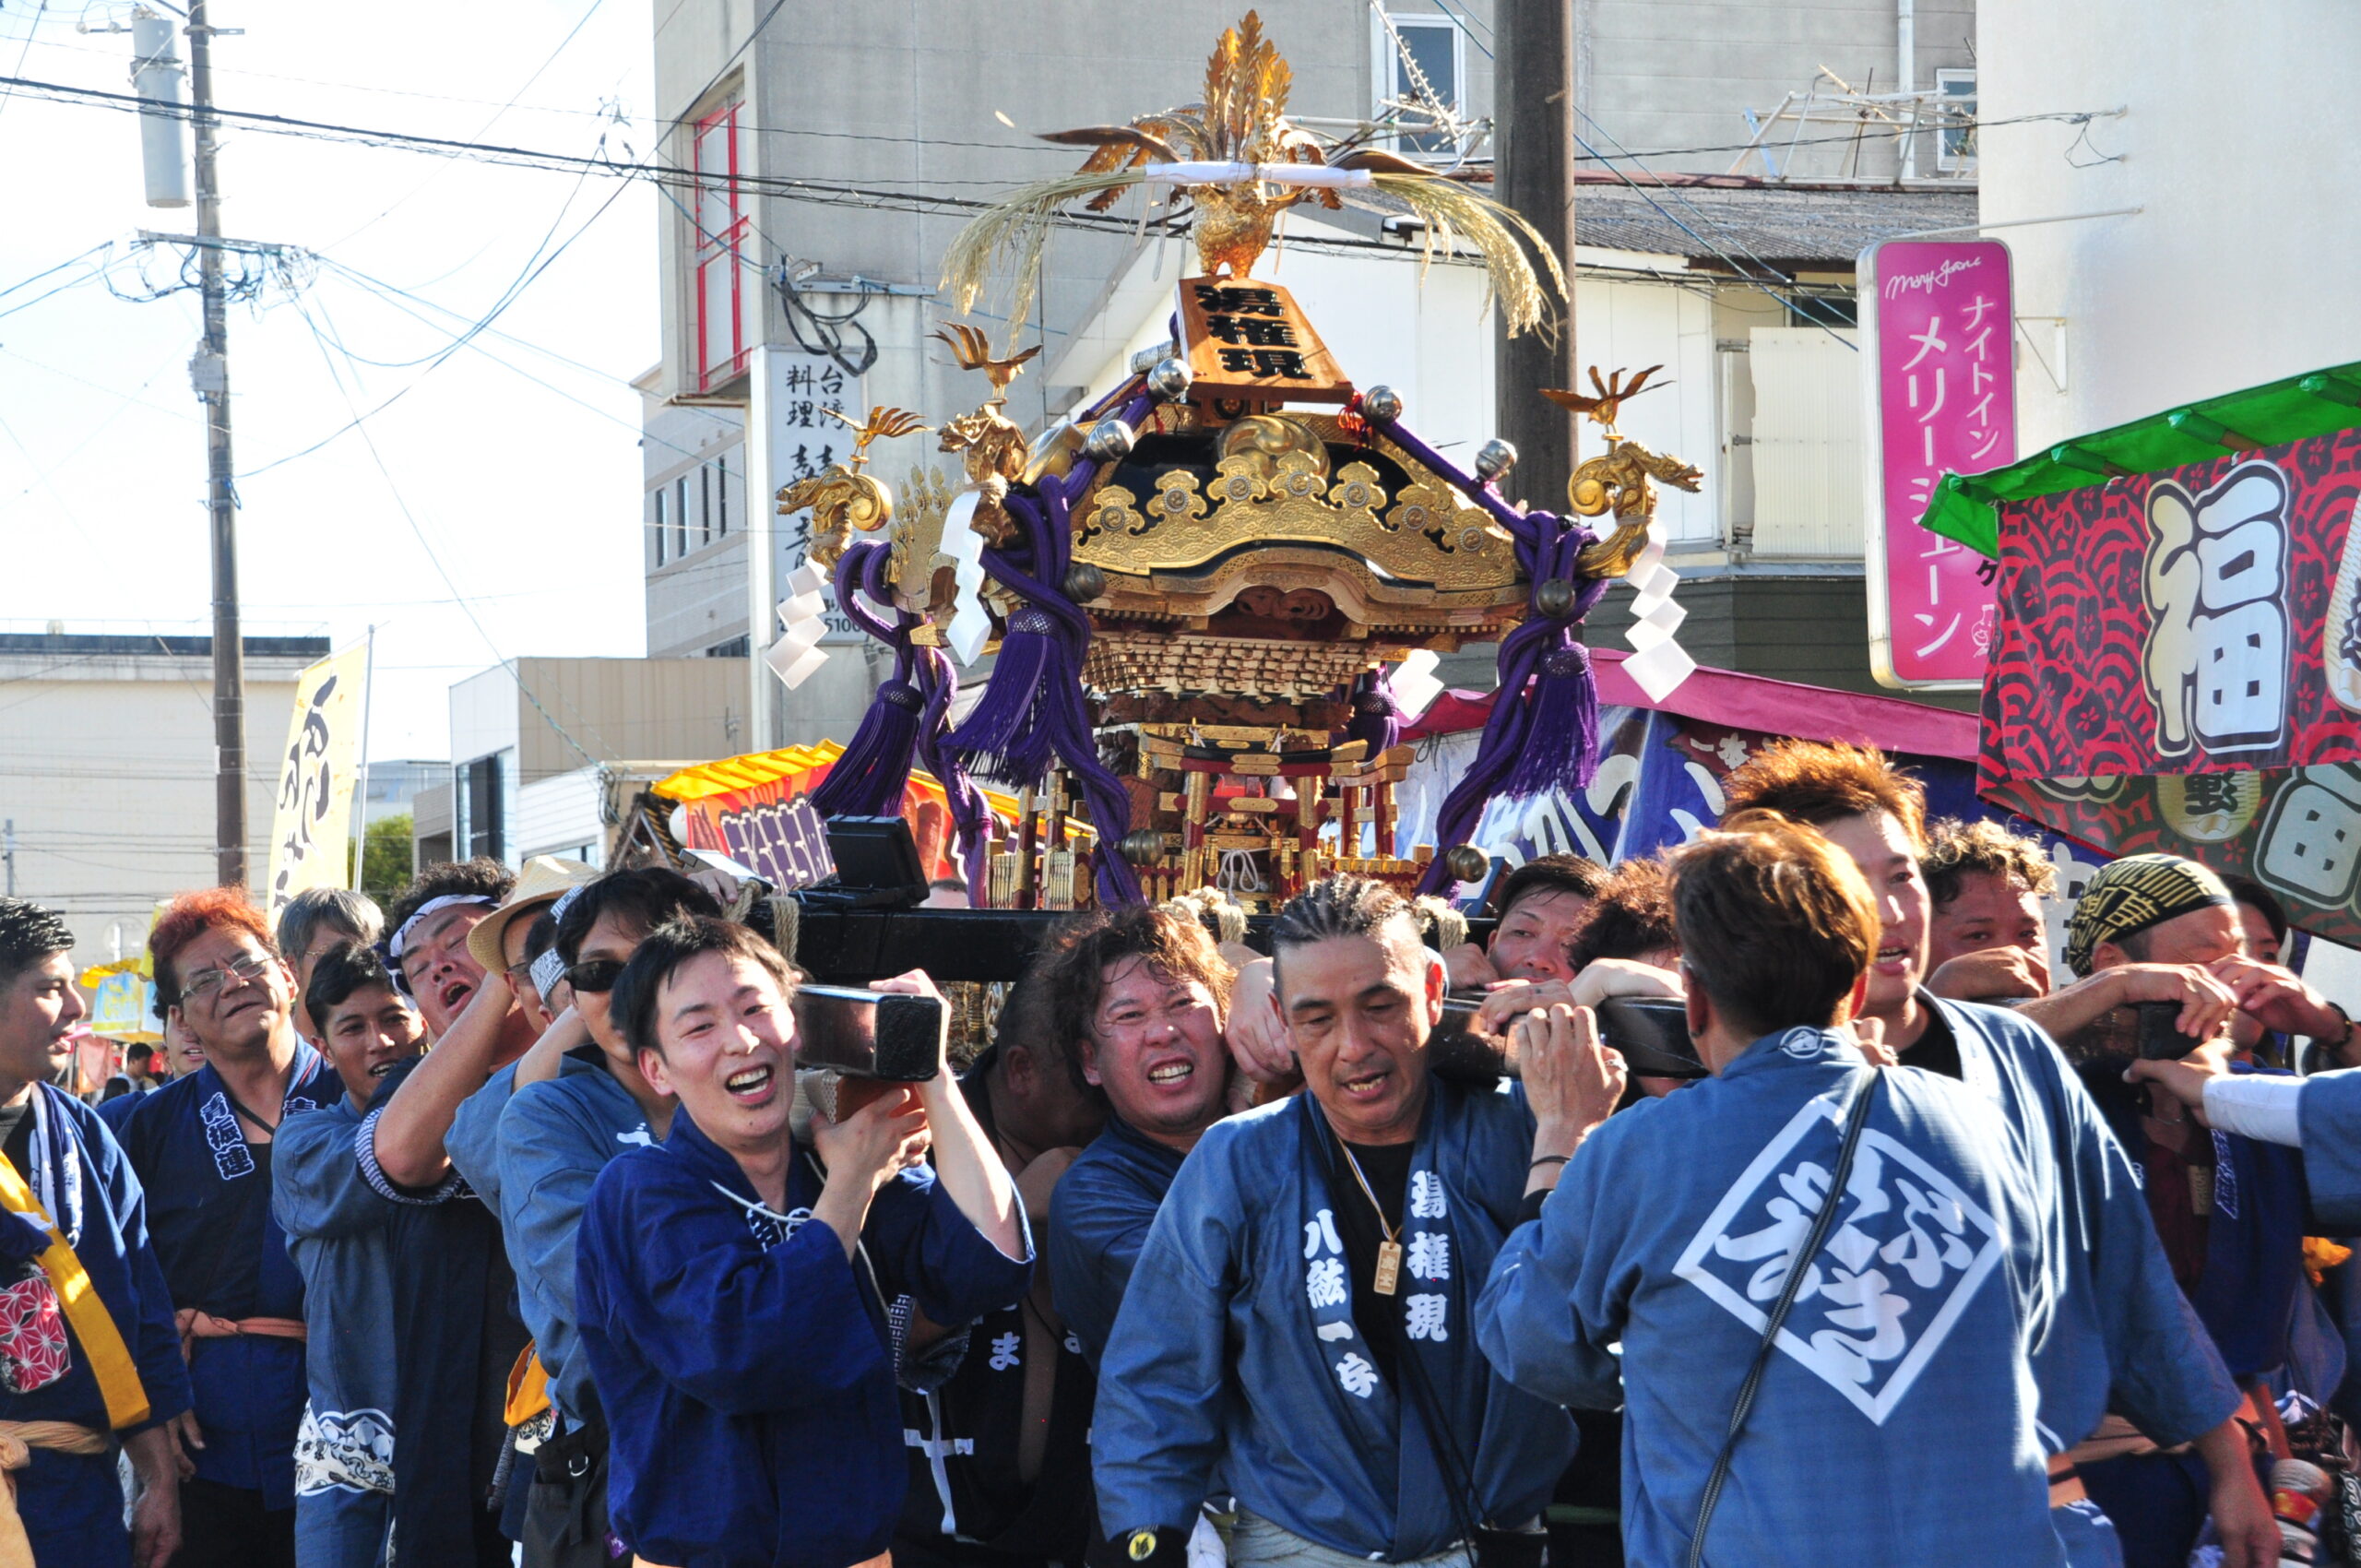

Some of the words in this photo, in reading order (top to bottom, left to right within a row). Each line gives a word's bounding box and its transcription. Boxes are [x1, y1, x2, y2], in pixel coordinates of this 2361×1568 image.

[786, 364, 818, 429] 料理
[820, 364, 845, 431] 台湾
[1962, 294, 1999, 460] ナイトイン
